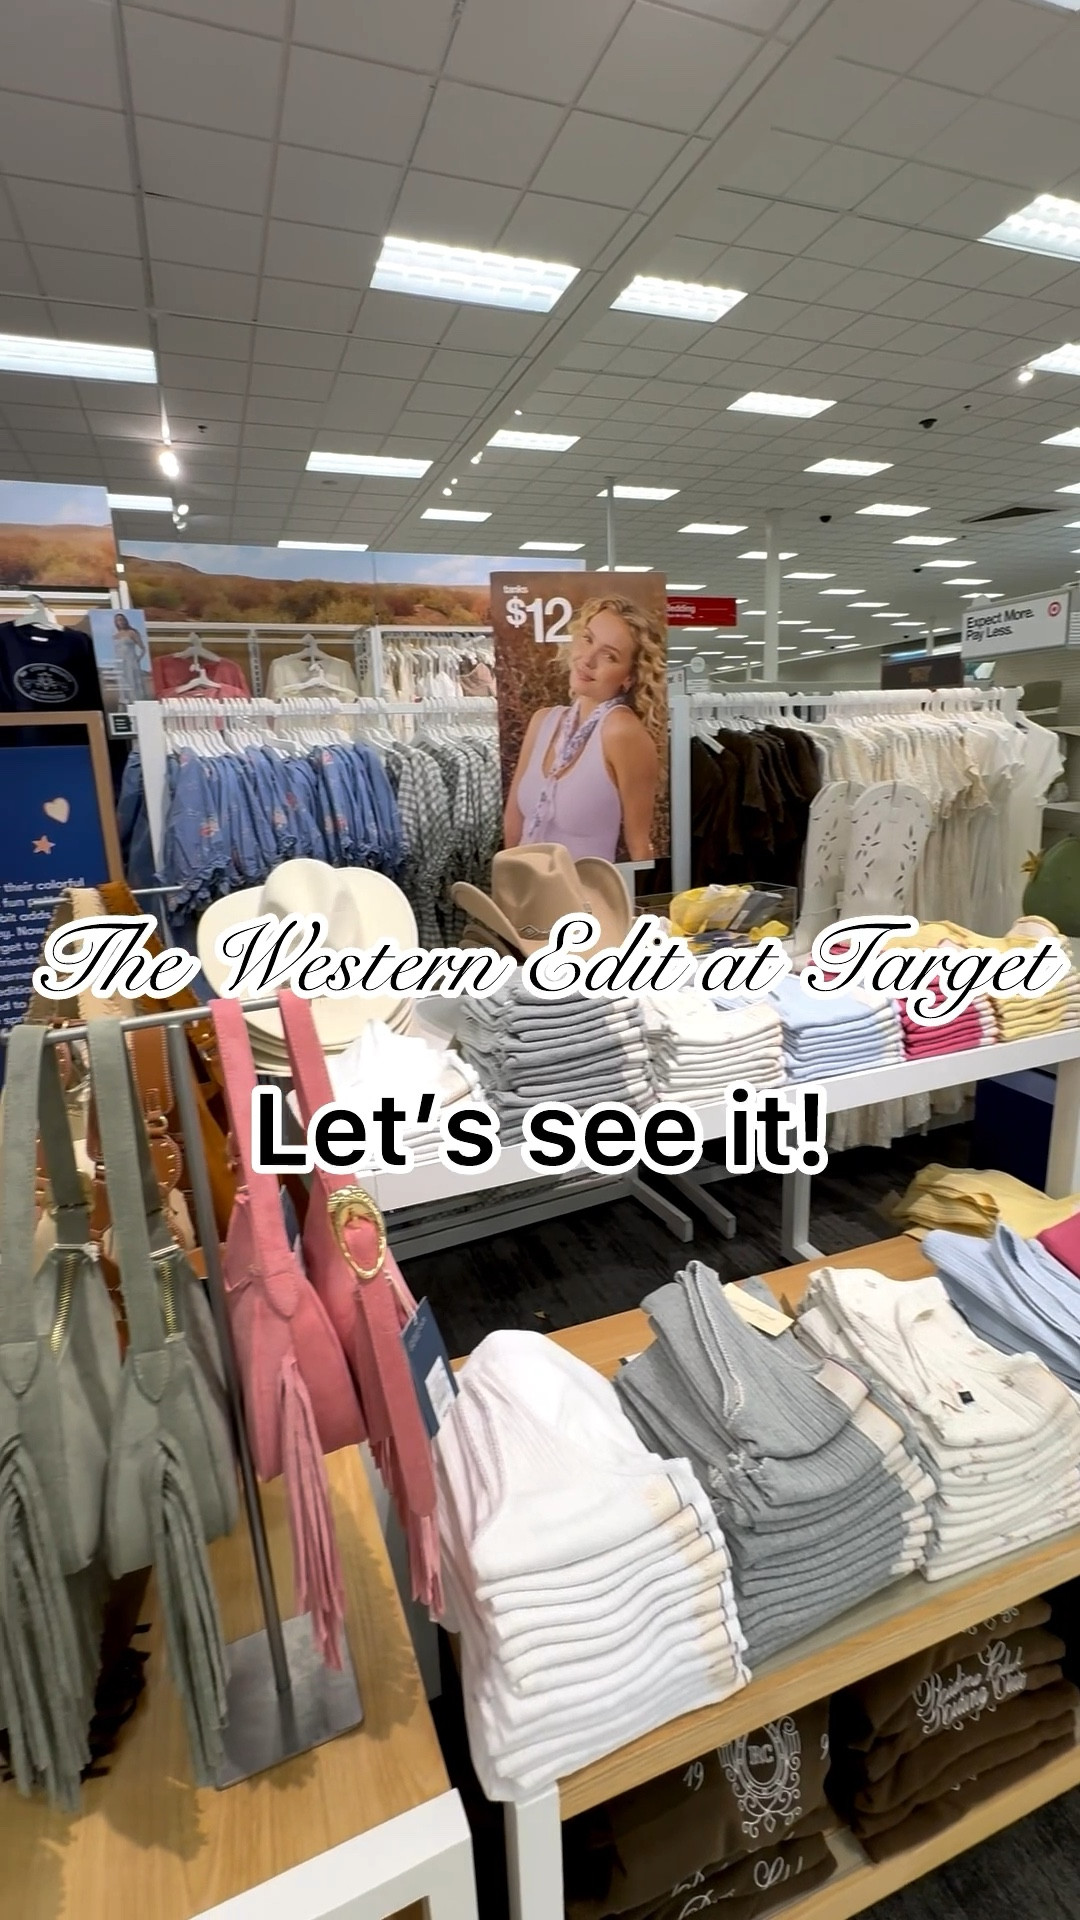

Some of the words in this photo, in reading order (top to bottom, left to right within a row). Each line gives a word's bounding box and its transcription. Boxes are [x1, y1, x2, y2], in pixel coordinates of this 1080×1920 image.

[505, 595, 573, 643] $12
[967, 612, 1002, 630] Expect
[1003, 608, 1035, 622] More.
[966, 629, 984, 642] Pay
[985, 626, 1013, 638] Less.
[3, 882, 34, 892] their
[35, 877, 85, 890] colorful
[2, 898, 25, 907] fun
[19, 910, 52, 921] adds
[16, 926, 45, 936] Now
[24, 942, 39, 950] to
[683, 1762, 704, 1791] 19
